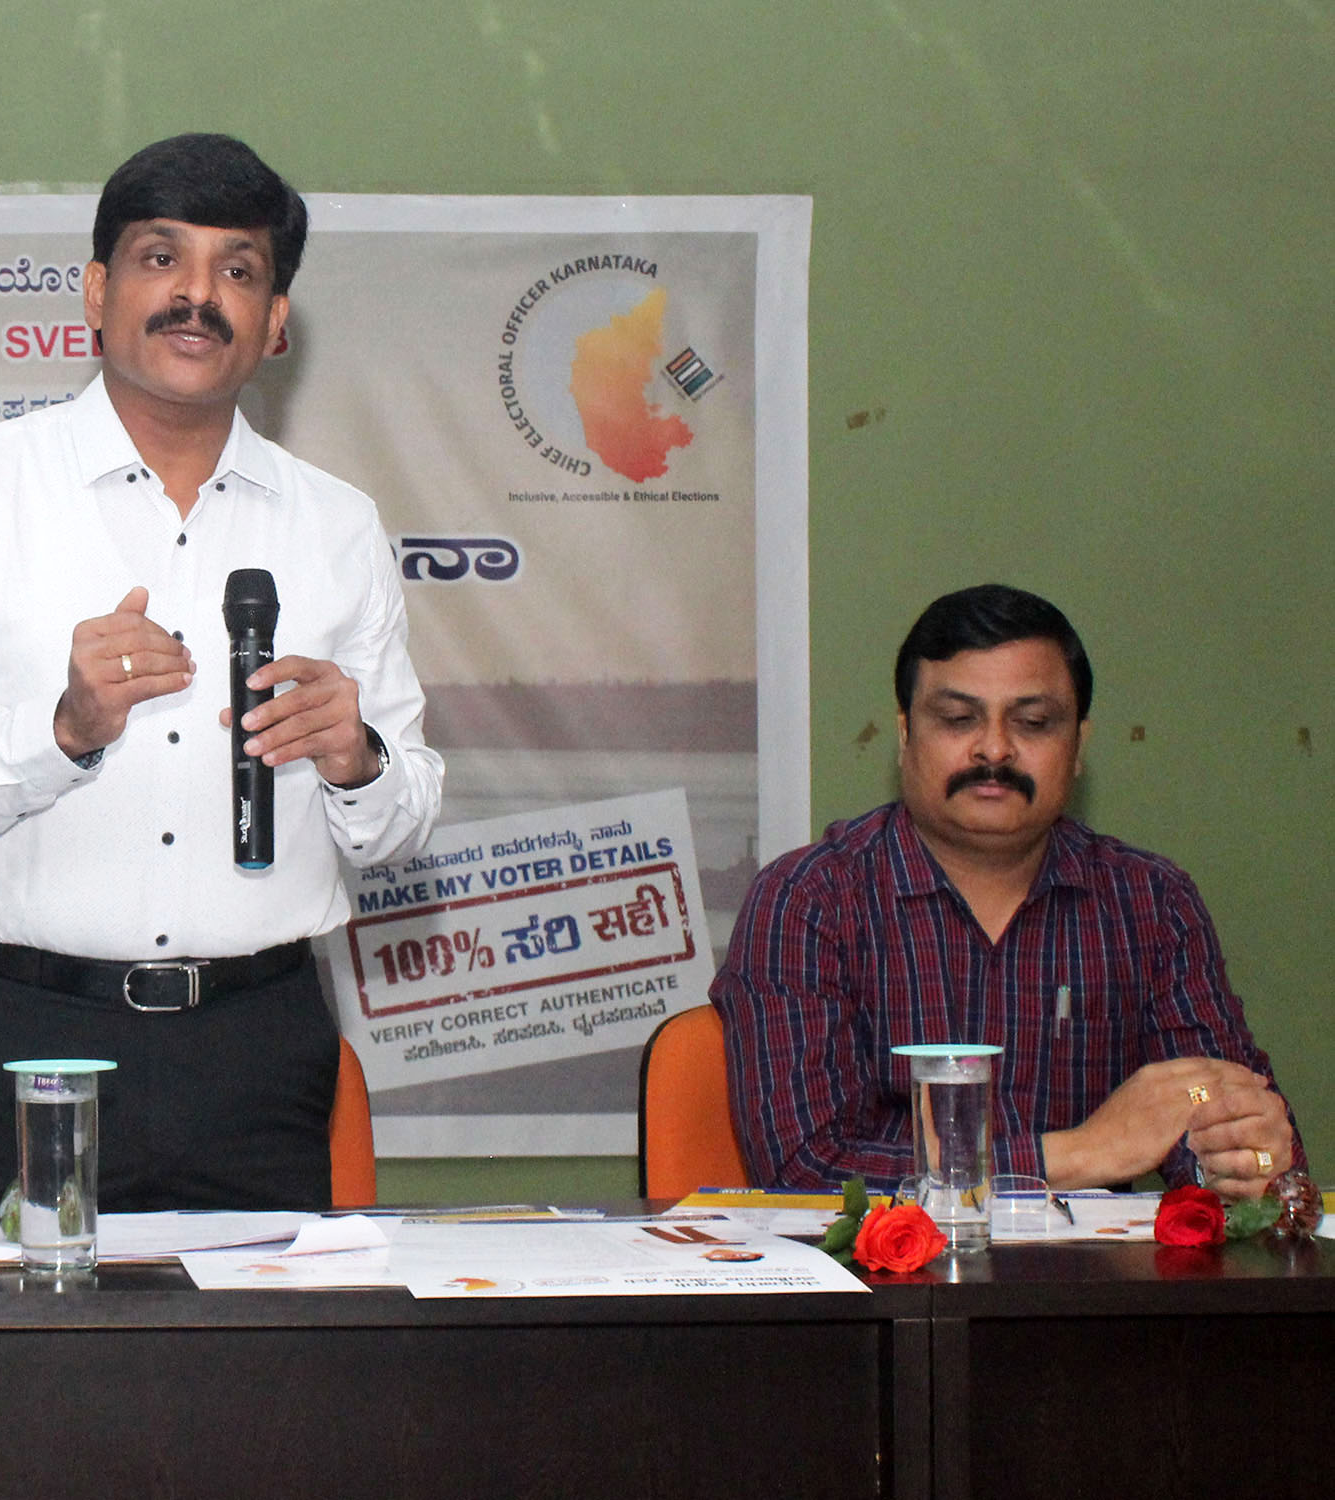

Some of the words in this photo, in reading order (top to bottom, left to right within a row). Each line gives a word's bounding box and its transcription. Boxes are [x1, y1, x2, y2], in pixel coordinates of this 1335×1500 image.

[551, 254, 658, 284] KARNATAKA
[502, 280, 550, 345] OFFICER
[499, 351, 543, 448] ELECTORAL
[541, 446, 591, 476] CHIEF
[562, 491, 619, 502] Accessible
[633, 491, 668, 501] Ethical
[672, 491, 719, 501] Elections
[358, 883, 428, 913] MAKE
[436, 873, 472, 898] MY
[482, 857, 564, 889] VOTER
[570, 837, 673, 873] DETAILS
[374, 928, 495, 985] 100%
[502, 915, 581, 964] ಸರಿ
[588, 885, 669, 942] सही
[370, 1020, 434, 1044] VERIFY
[441, 1002, 528, 1031] CORRECT
[540, 974, 679, 1013] AUTHENTICATE
